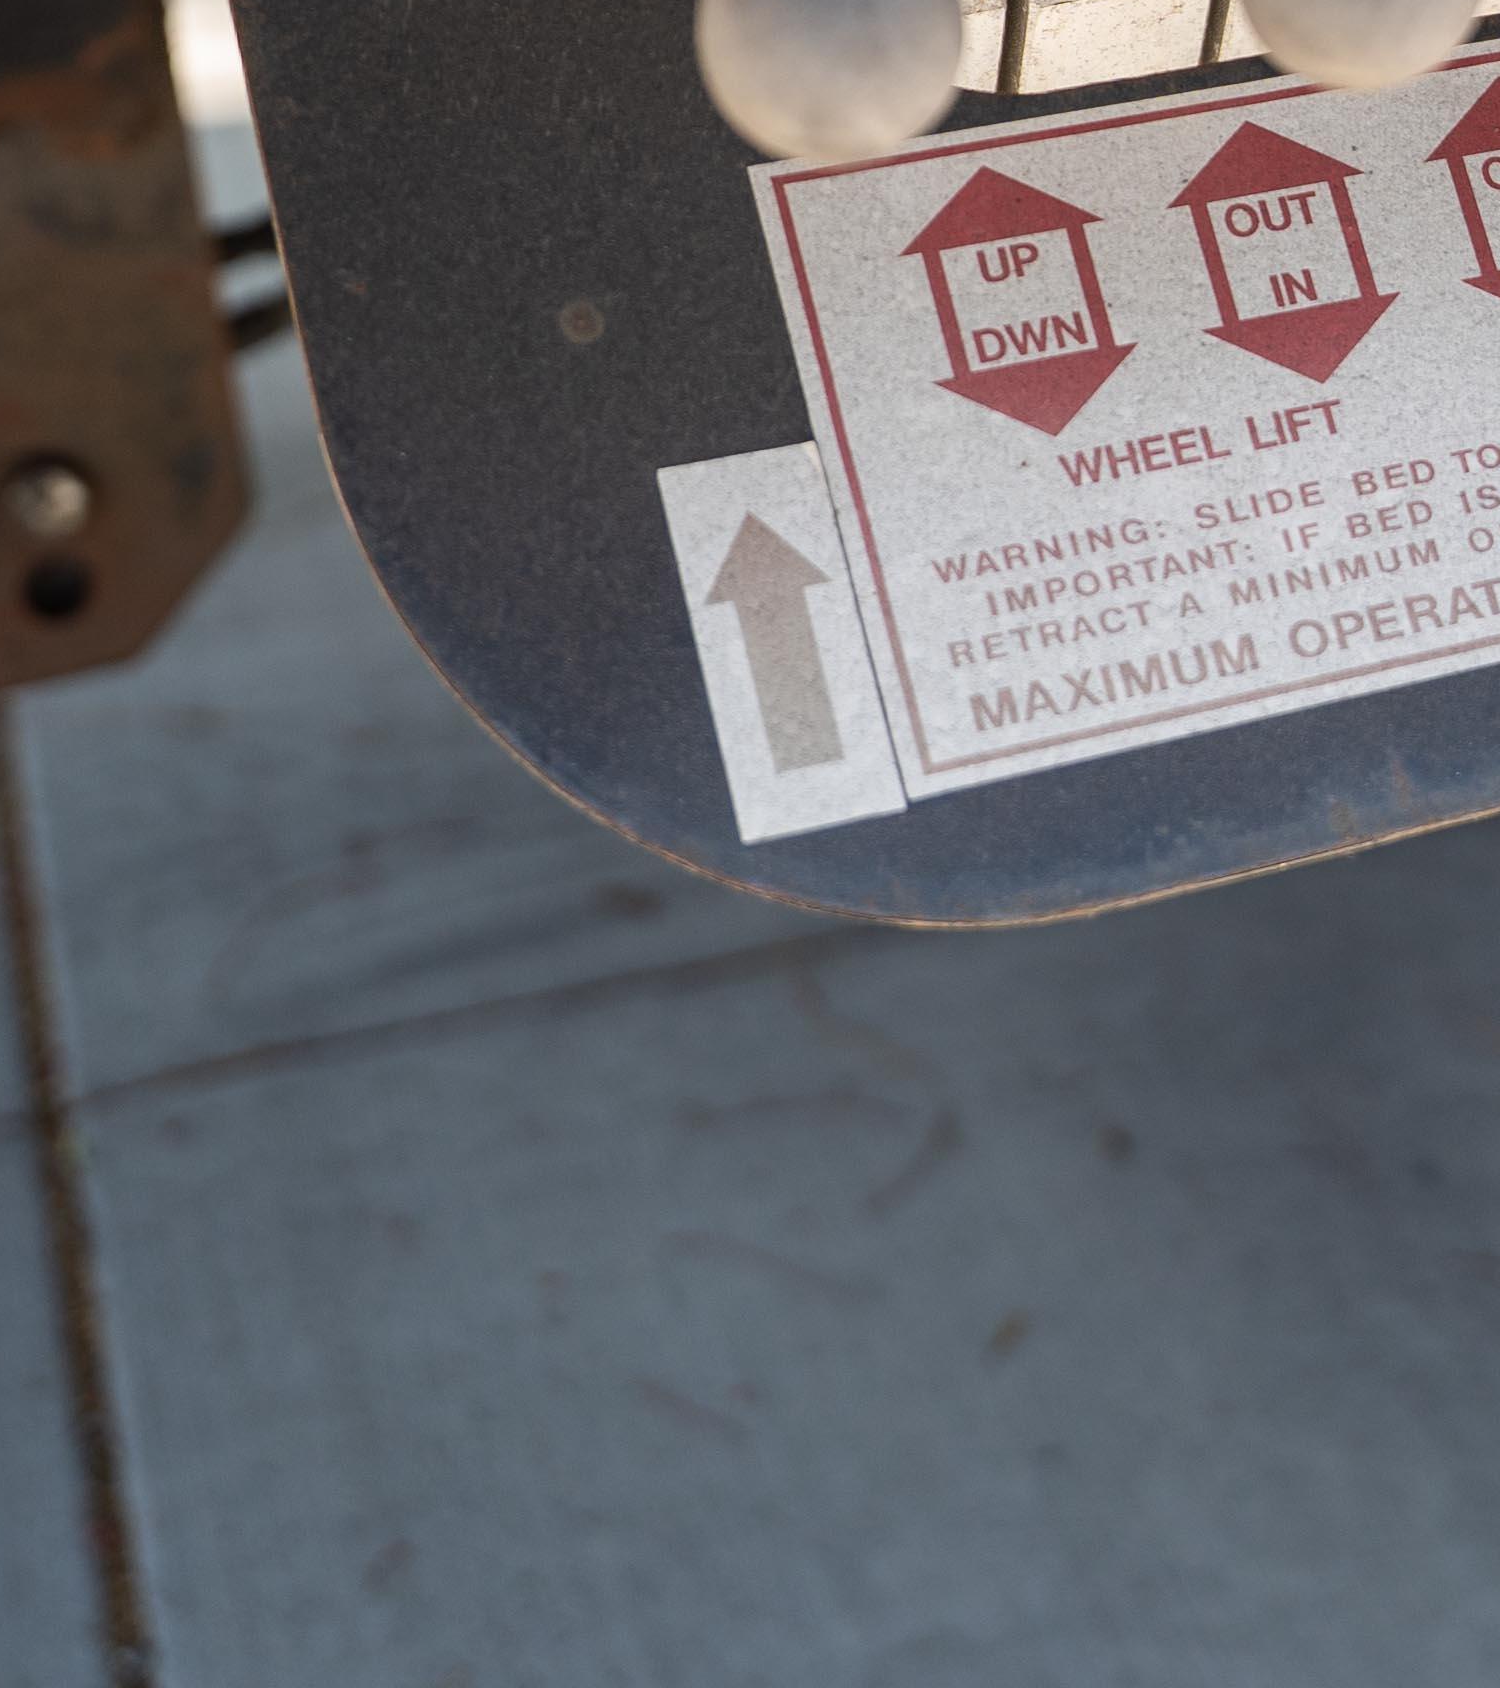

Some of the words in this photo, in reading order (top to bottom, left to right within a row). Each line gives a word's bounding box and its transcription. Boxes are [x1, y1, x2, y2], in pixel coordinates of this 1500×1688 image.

[1220, 189, 1325, 240] OUT
[974, 240, 1045, 285] UP
[1267, 267, 1319, 308] IN
[969, 308, 1090, 365] DWN
[1057, 421, 1232, 490] WHEEL
[1243, 397, 1348, 451] LIFT
[930, 511, 1169, 588] WARNING:
[1191, 479, 1326, 532] SLIDE
[1350, 456, 1438, 498] BED
[984, 535, 1255, 619] IMPORTANT:
[1279, 521, 1324, 554] IF
[1343, 497, 1435, 541] BED
[946, 599, 1156, 670] RETRACT
[1174, 588, 1206, 619] A
[1226, 536, 1443, 608] MINIMUM
[965, 630, 1264, 735] MAXIMUM
